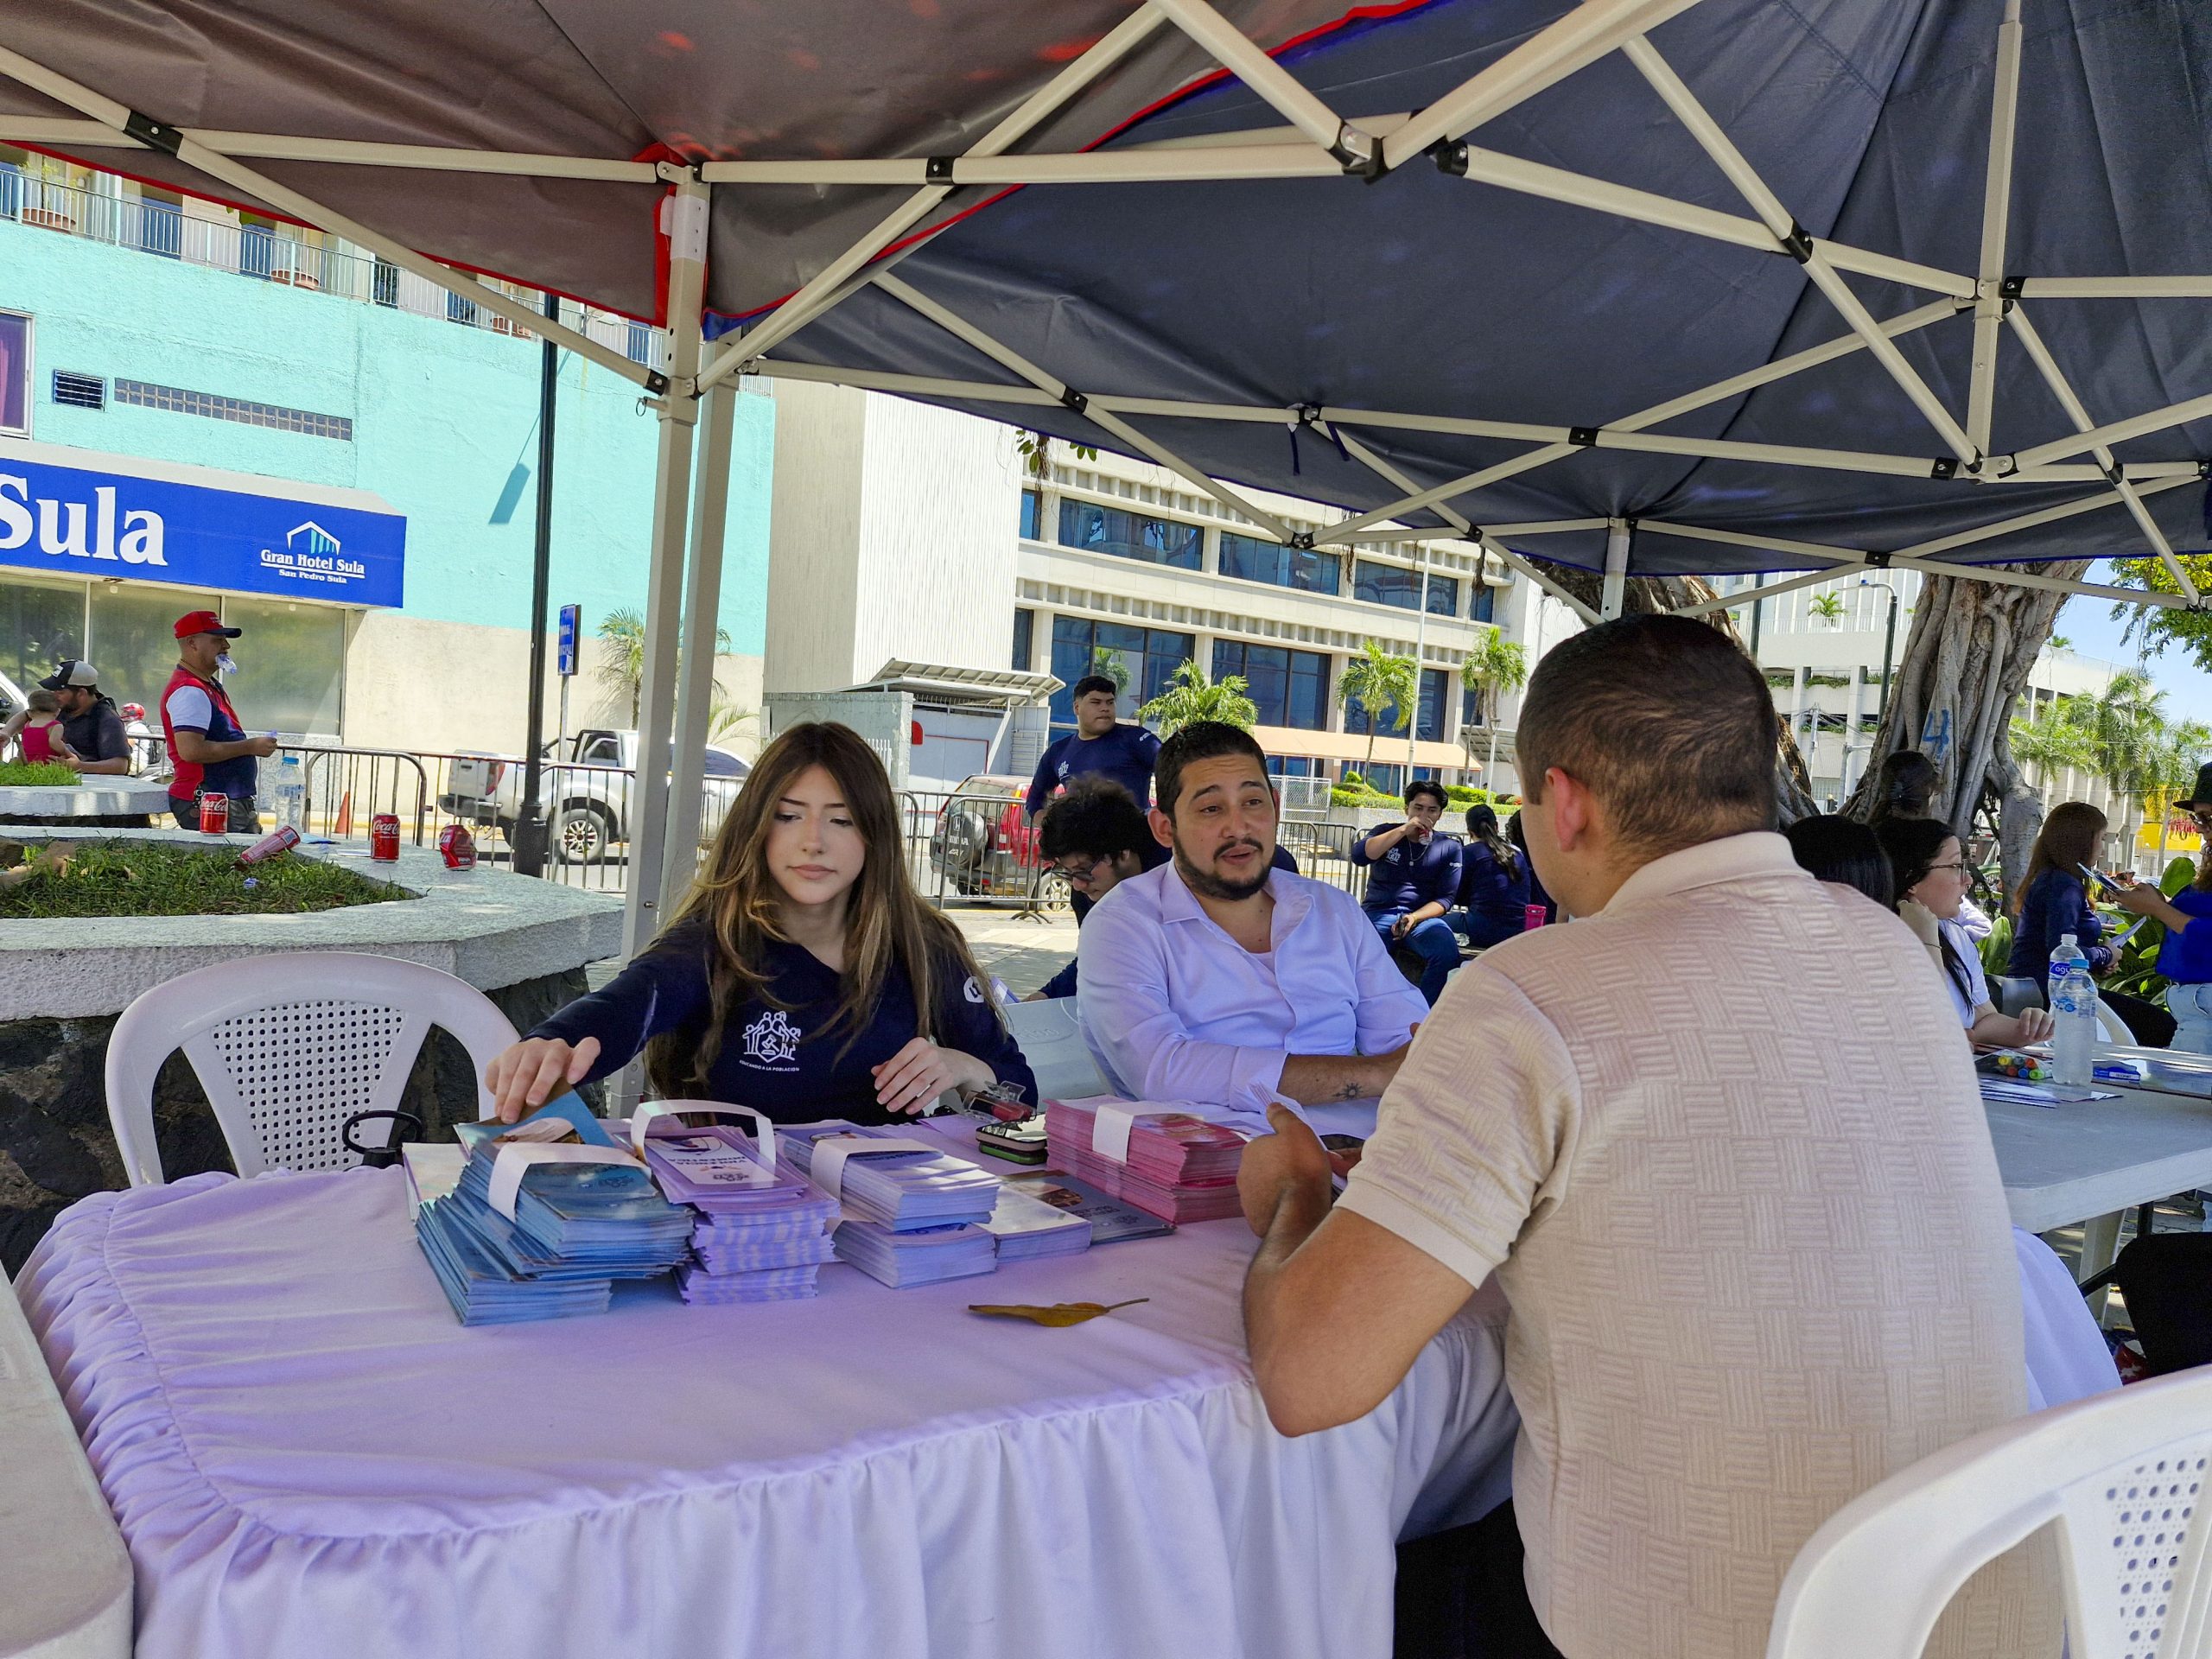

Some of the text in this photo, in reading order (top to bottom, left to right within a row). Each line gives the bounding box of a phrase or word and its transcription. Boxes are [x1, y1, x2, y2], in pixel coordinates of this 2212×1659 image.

[0, 474, 168, 566] Sula
[260, 549, 365, 574] Gran Hotel Sula
[279, 569, 347, 584] San Pedro Sula
[739, 1059, 761, 1070] EDUCANDO
